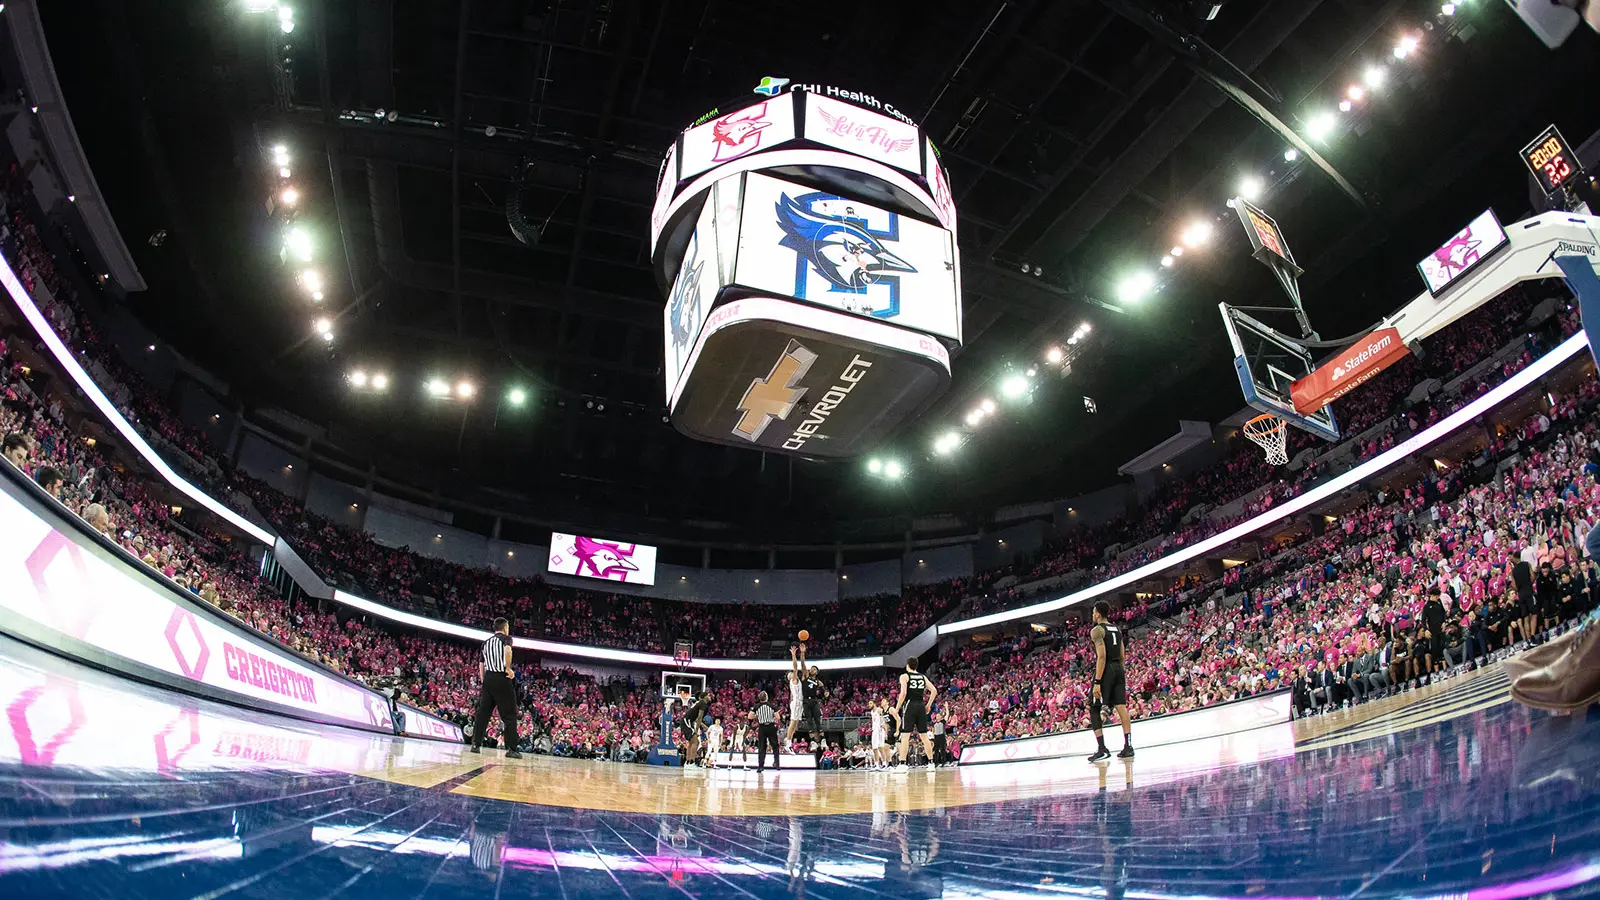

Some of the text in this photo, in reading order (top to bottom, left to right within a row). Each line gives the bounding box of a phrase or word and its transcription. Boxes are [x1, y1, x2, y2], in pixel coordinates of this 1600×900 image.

[826, 85, 881, 110] Health
[695, 107, 720, 126] OMAHA
[866, 126, 896, 153] Fly
[1529, 136, 1562, 171] 20:00
[1559, 241, 1596, 257] SPALDING
[781, 354, 873, 450] CHEVROLET
[1111, 632, 1118, 646] 1
[223, 641, 317, 704] CREIGHTON
[909, 680, 925, 689] 32
